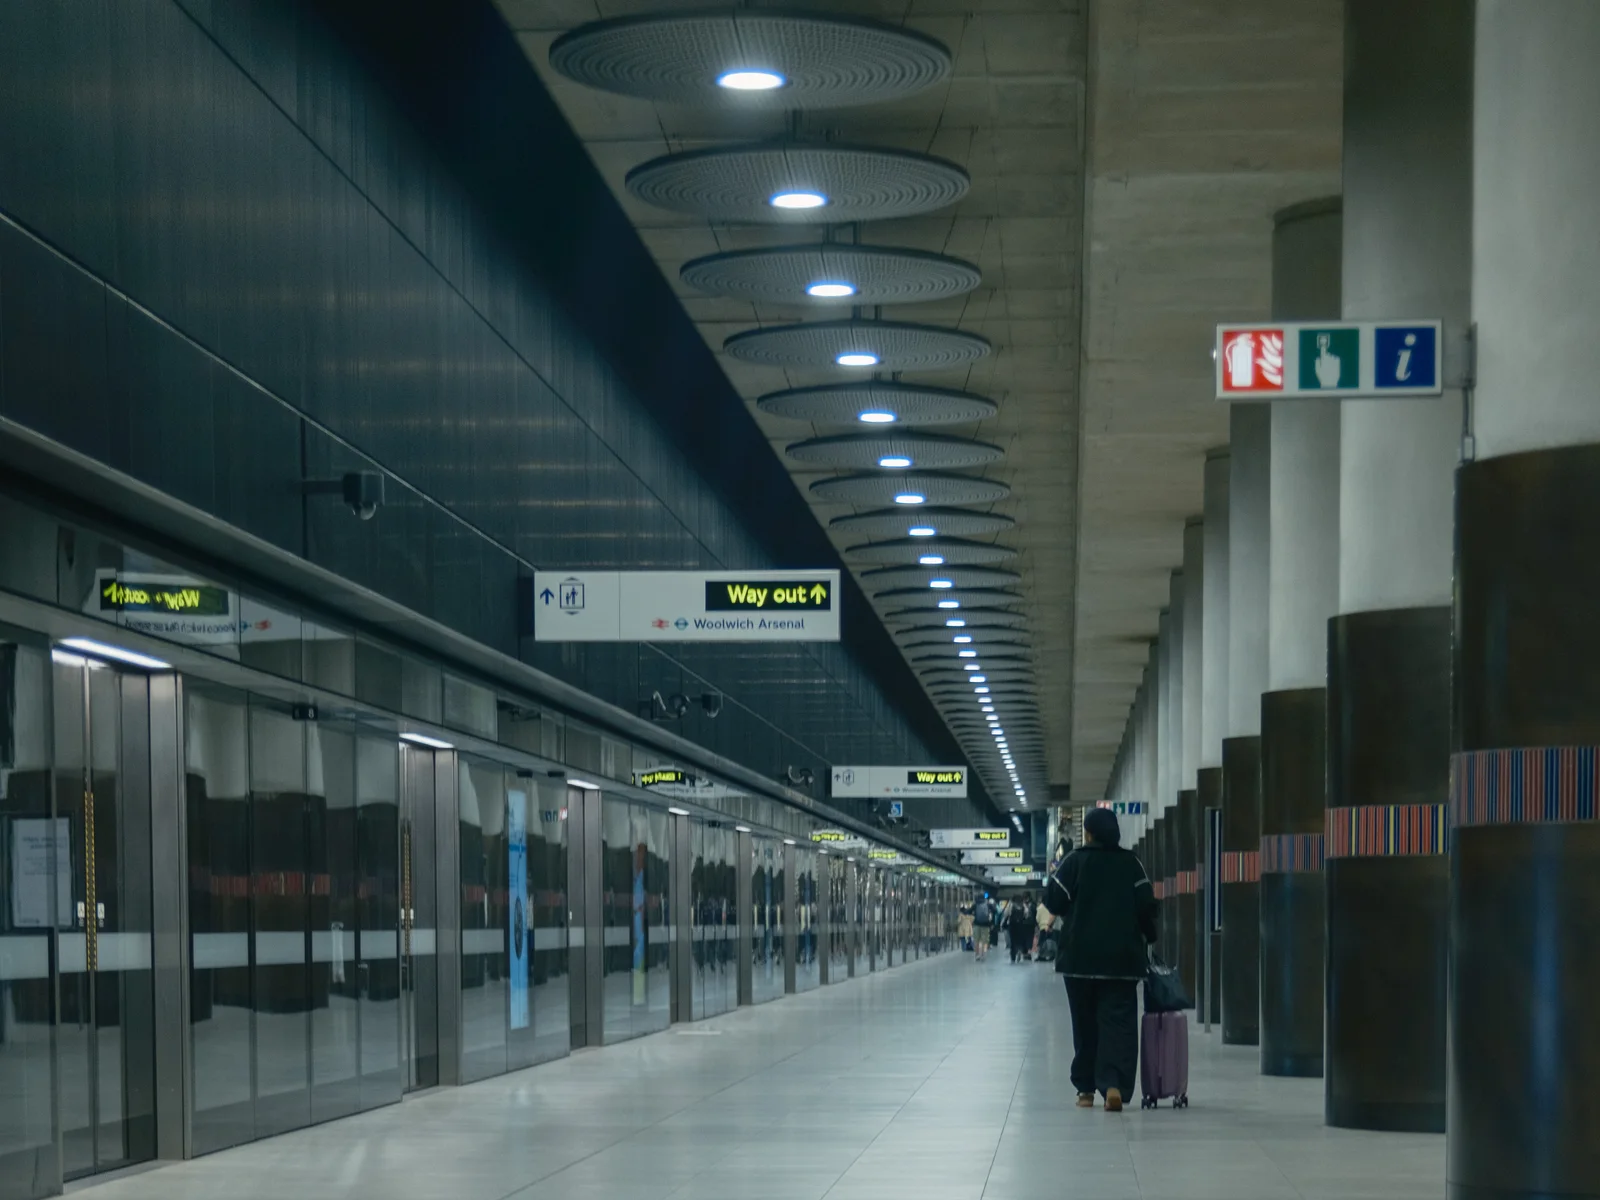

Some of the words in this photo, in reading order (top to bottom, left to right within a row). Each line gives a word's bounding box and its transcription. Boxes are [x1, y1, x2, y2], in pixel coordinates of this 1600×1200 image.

[727, 584, 768, 607] Way
[773, 586, 807, 603] out
[694, 618, 754, 630] Woolwich
[758, 618, 805, 630] Arsenal
[916, 772, 936, 784] Way
[937, 773, 952, 782] out
